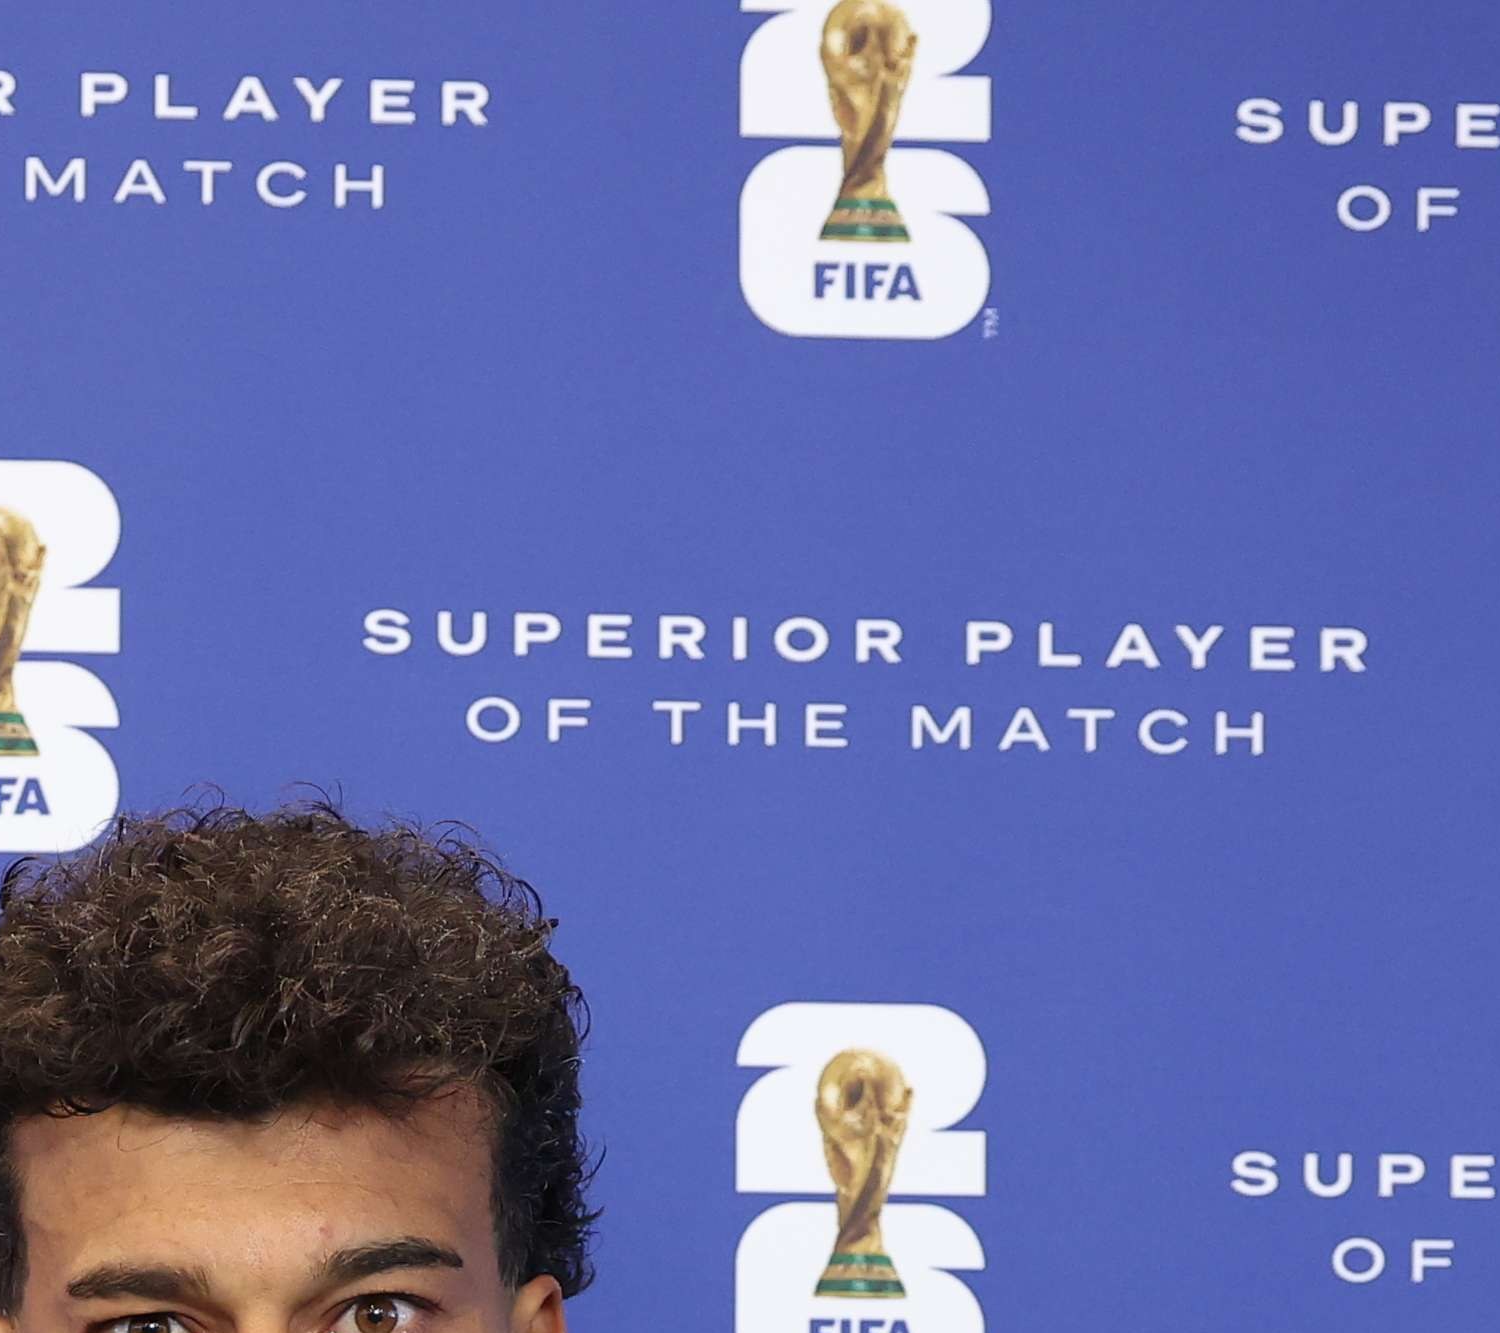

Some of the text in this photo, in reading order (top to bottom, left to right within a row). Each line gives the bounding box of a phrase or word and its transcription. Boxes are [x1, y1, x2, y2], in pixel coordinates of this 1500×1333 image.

[80, 72, 489, 126] PLAYER
[25, 156, 384, 210] MATCH
[1336, 185, 1460, 232] OF
[814, 263, 920, 300] FIFA
[362, 609, 1368, 673] SUPERIOR PLAYER
[466, 696, 1264, 756] OF THE MATCH
[1332, 1237, 1455, 1283] OF
